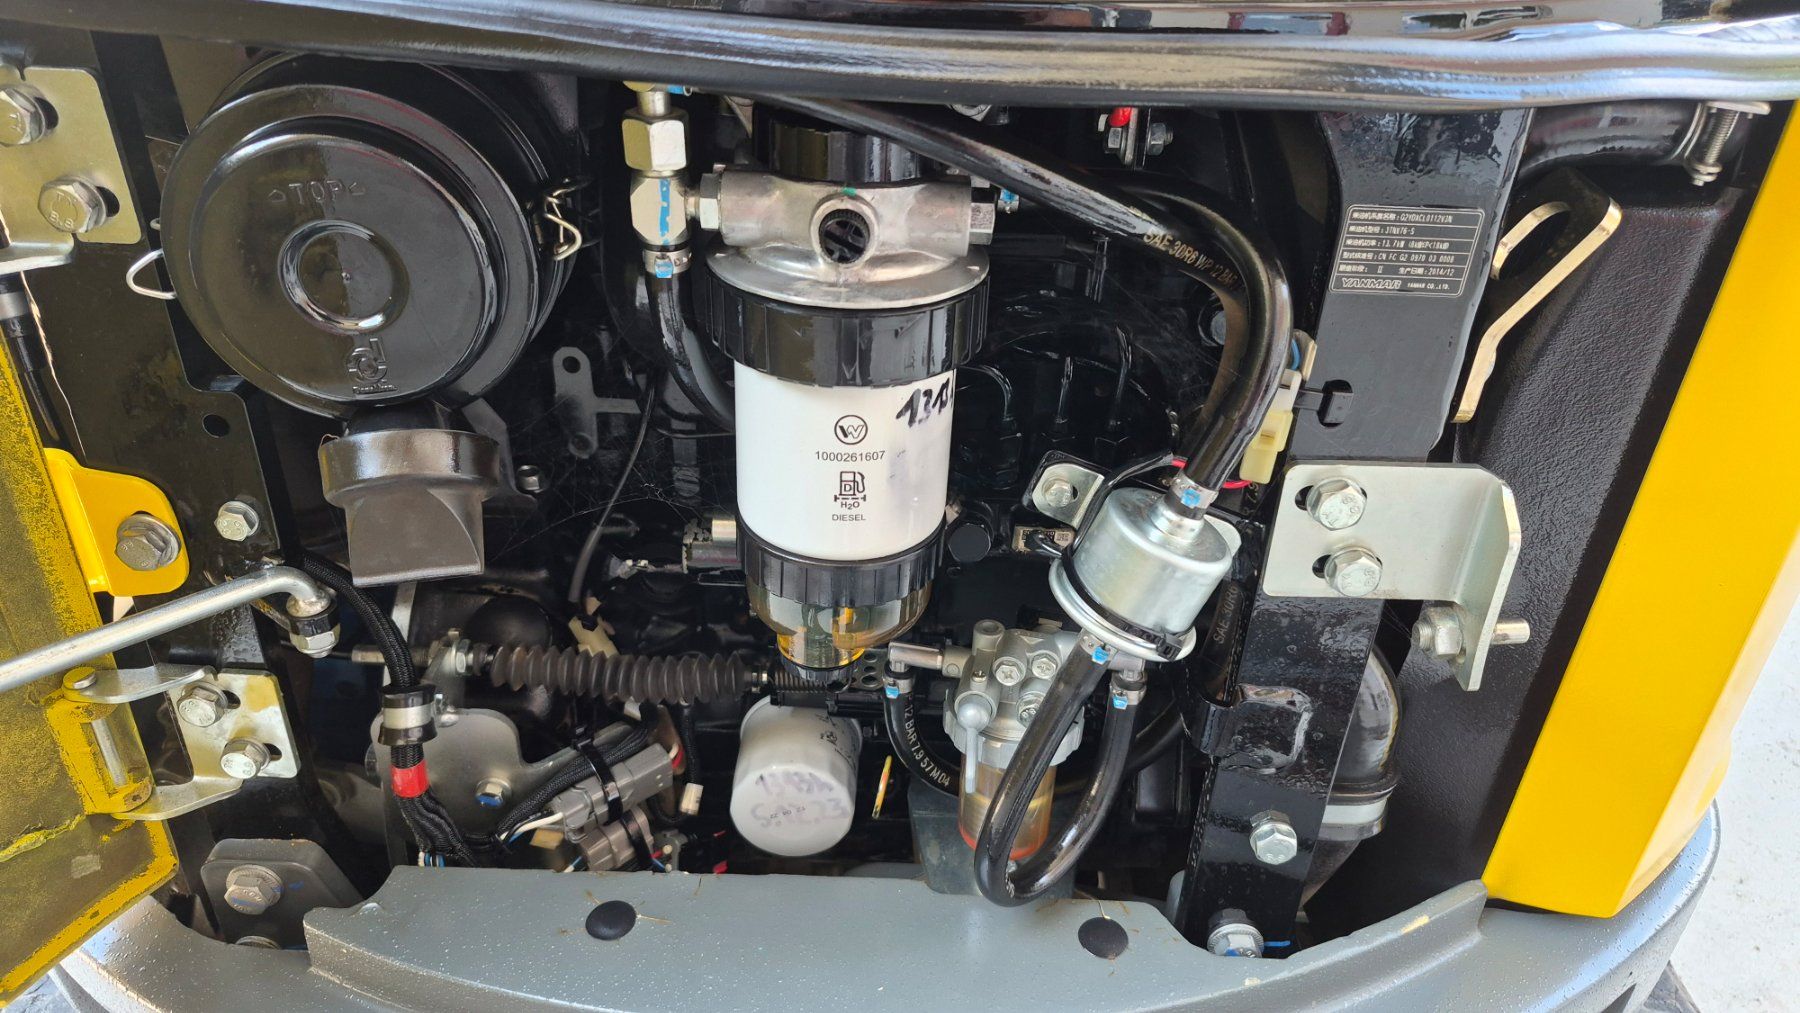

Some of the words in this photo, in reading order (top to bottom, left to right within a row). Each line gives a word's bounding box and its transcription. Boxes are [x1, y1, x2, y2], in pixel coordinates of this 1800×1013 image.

[1143, 231, 1174, 252] SAE
[1341, 278, 1402, 290] YANMAR
[815, 450, 886, 462] 1000261607
[831, 513, 867, 522] DIESEL
[905, 720, 918, 745] BAR
